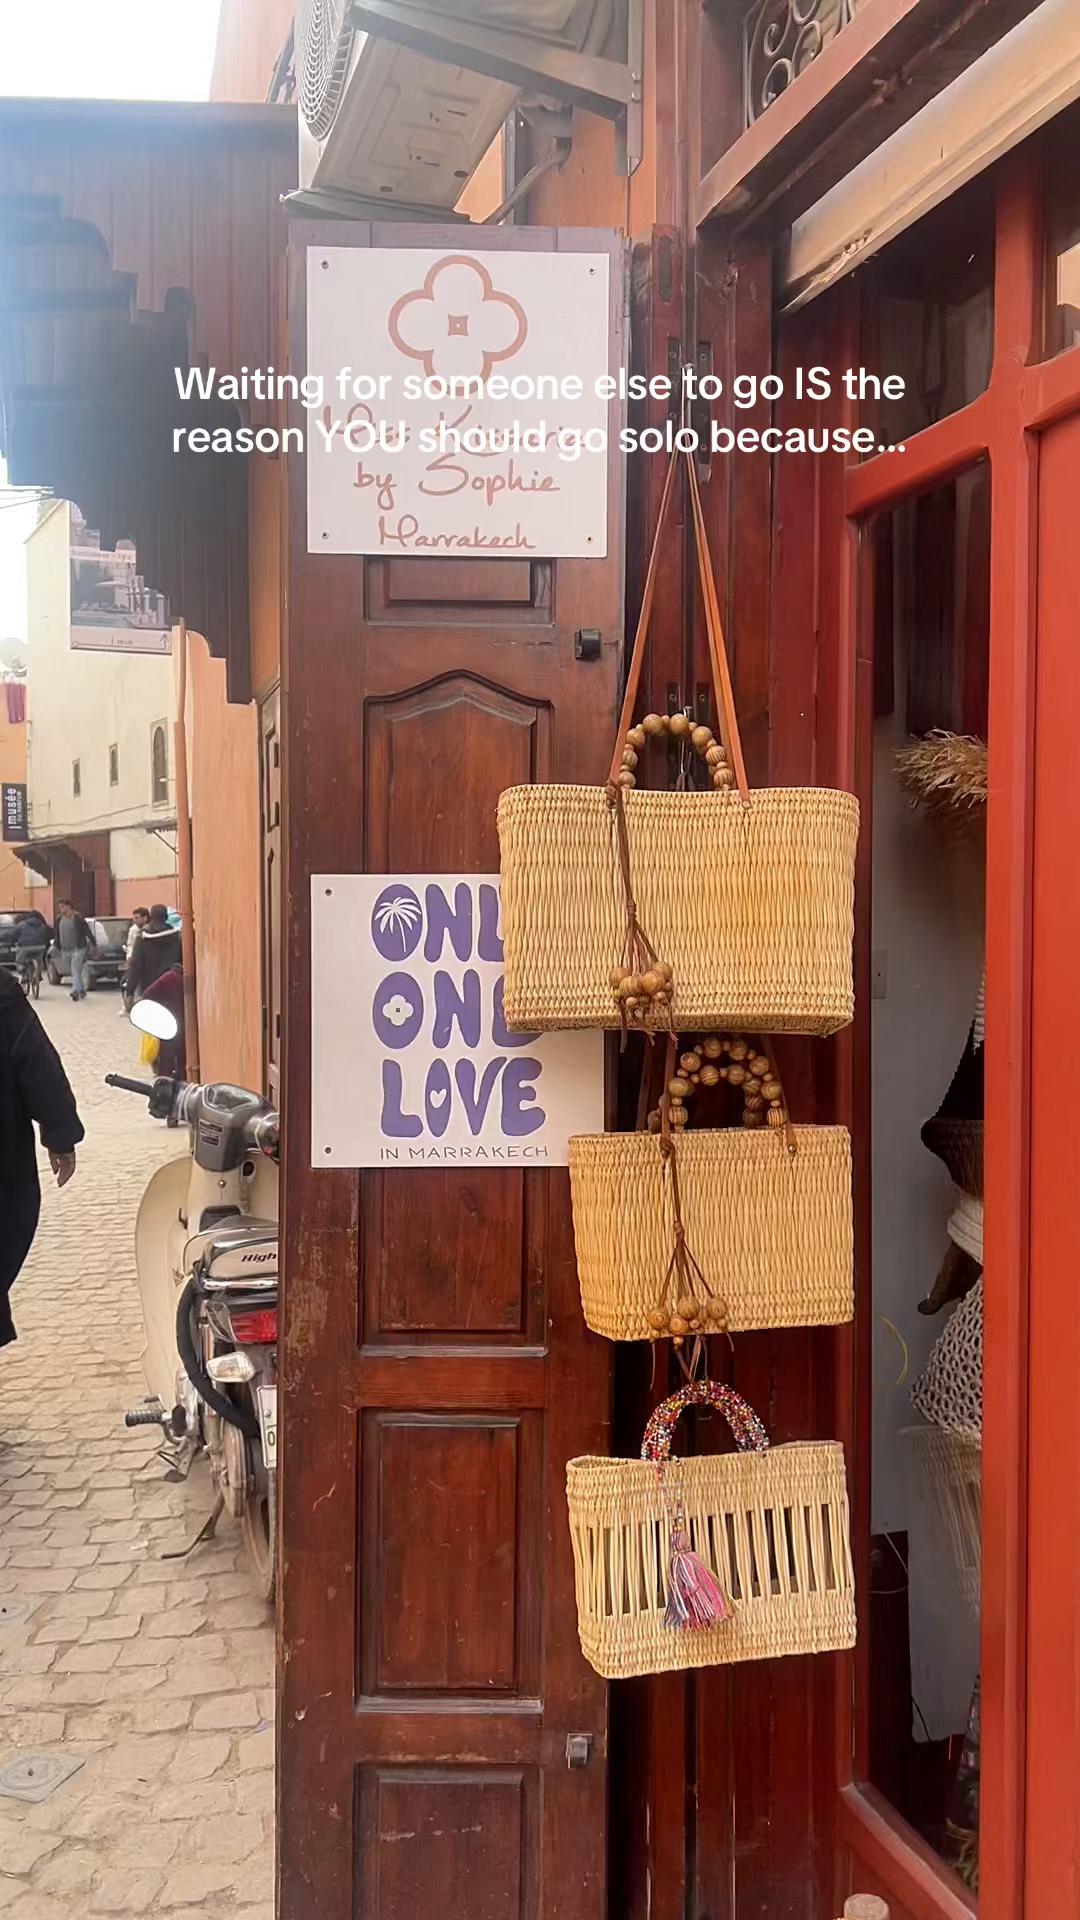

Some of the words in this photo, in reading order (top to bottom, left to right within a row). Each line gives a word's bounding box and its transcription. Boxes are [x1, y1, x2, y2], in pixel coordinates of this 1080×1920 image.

[353, 461, 397, 511] by
[418, 452, 561, 506] Sophie
[378, 513, 537, 549] Marrakech
[5, 788, 16, 824] musée
[371, 882, 505, 963] ONL
[381, 1056, 546, 1138] LOVE
[380, 1146, 399, 1160] IN
[409, 1145, 549, 1160] MARRAKECH
[241, 1252, 277, 1263] High
